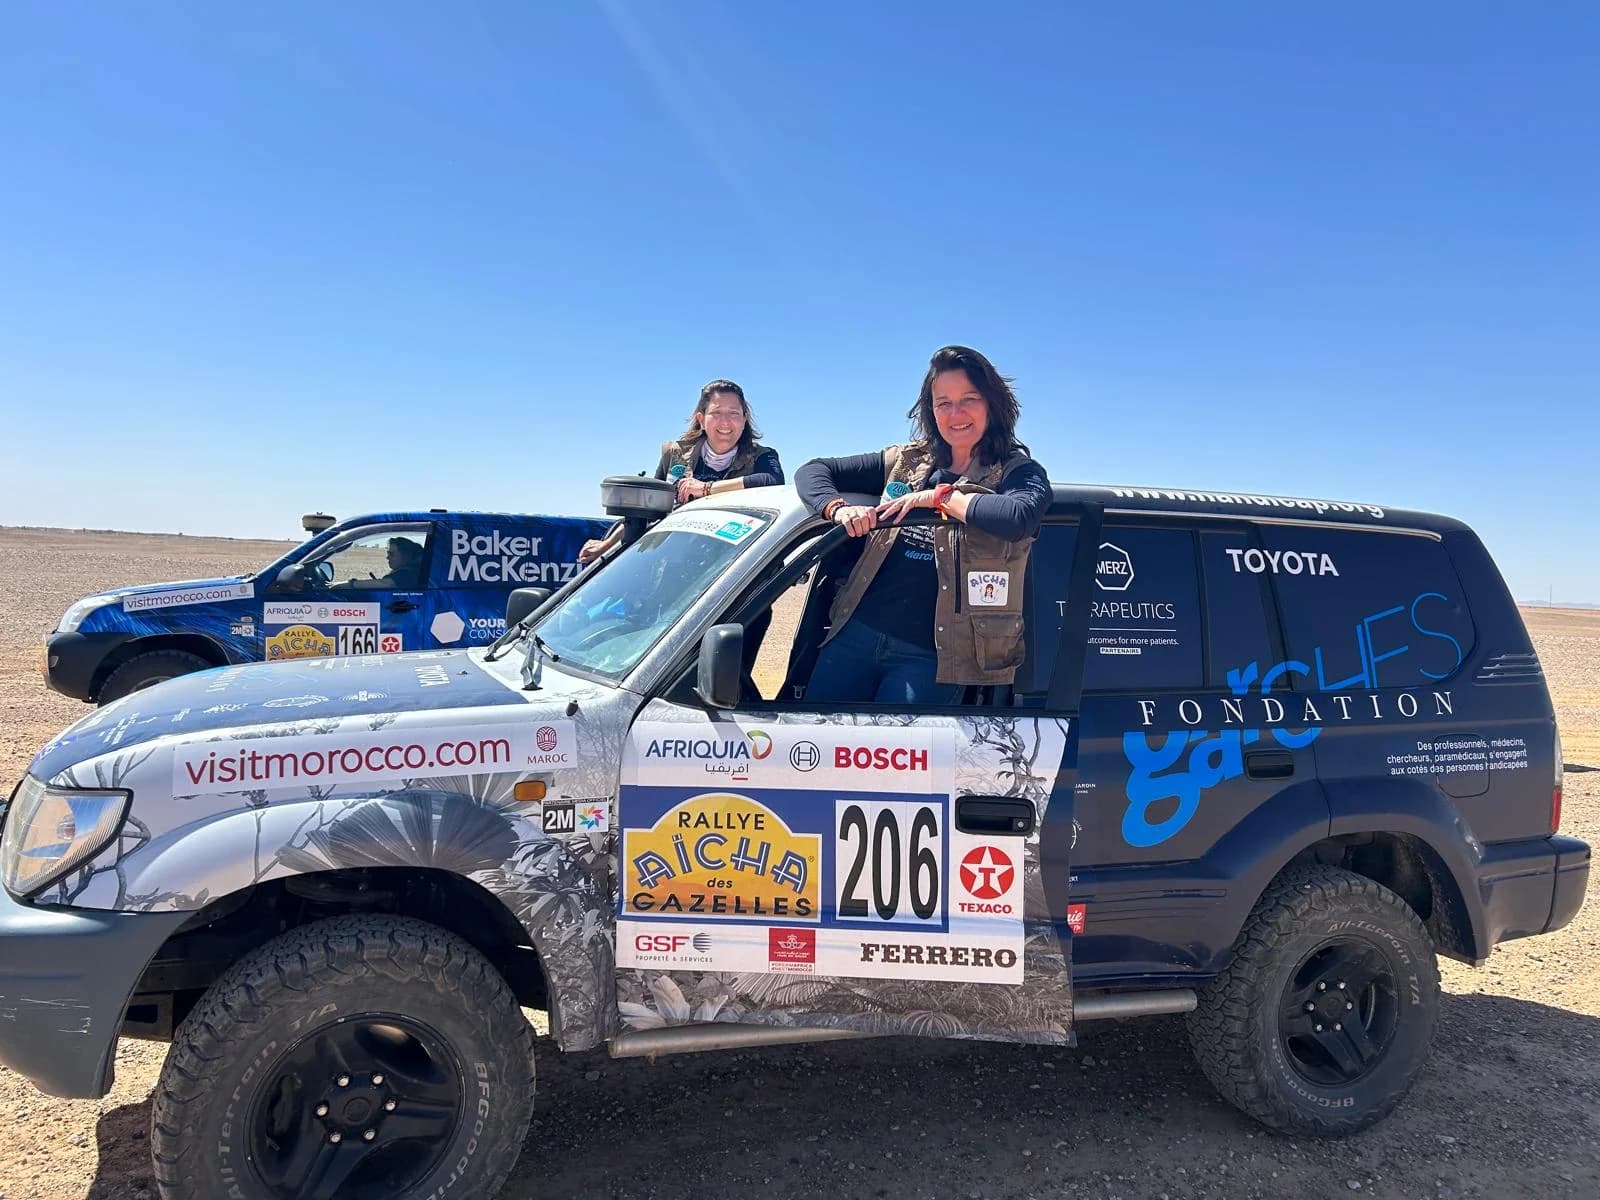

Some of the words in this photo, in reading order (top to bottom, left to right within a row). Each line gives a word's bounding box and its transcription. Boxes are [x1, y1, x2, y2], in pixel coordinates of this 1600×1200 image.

[452, 529, 543, 556] Baker
[448, 555, 583, 582] McKenzi
[1096, 560, 1128, 575] MERZ
[1225, 548, 1340, 576] TOYOTA
[127, 588, 232, 609] visitmorocco.com
[266, 607, 304, 615] AFRIQUIA
[333, 609, 366, 617] BOSCH
[1055, 600, 1175, 619] TRAPEUTICS
[231, 626, 243, 635] 2M
[469, 618, 506, 628] YOUR
[340, 627, 374, 655] 166
[468, 629, 507, 639] CONS
[1087, 637, 1118, 645] utcomes
[1118, 636, 1129, 645] for
[1150, 637, 1179, 647] patients.
[1138, 691, 1454, 725] FONDATION
[645, 739, 750, 760] AFRIQUIA
[1417, 741, 1433, 751] Des
[1434, 739, 1489, 752] professionnels,
[1491, 738, 1526, 748] médecins,
[185, 737, 512, 785] visitmorocco.com
[527, 753, 568, 764] MAROC
[834, 746, 929, 771] BOSCH
[1386, 753, 1433, 764] chercheurs,
[1435, 751, 1488, 763] paramédicaux,
[1489, 749, 1527, 760] s'engagent
[1390, 767, 1405, 775] aux
[1430, 764, 1444, 773] des
[1446, 762, 1484, 774] personnes
[544, 808, 574, 830] 2M
[678, 812, 765, 830] RALLYE
[632, 833, 808, 895] AÏCHA
[839, 804, 939, 921] 206
[707, 877, 733, 889] des
[632, 892, 812, 916] GAZELLES
[958, 902, 1012, 914] TEXACO
[635, 935, 690, 953] GSF
[1327, 919, 1412, 965] All-Terrain
[860, 943, 1018, 968] FERRERO
[289, 1003, 338, 1032] T/A
